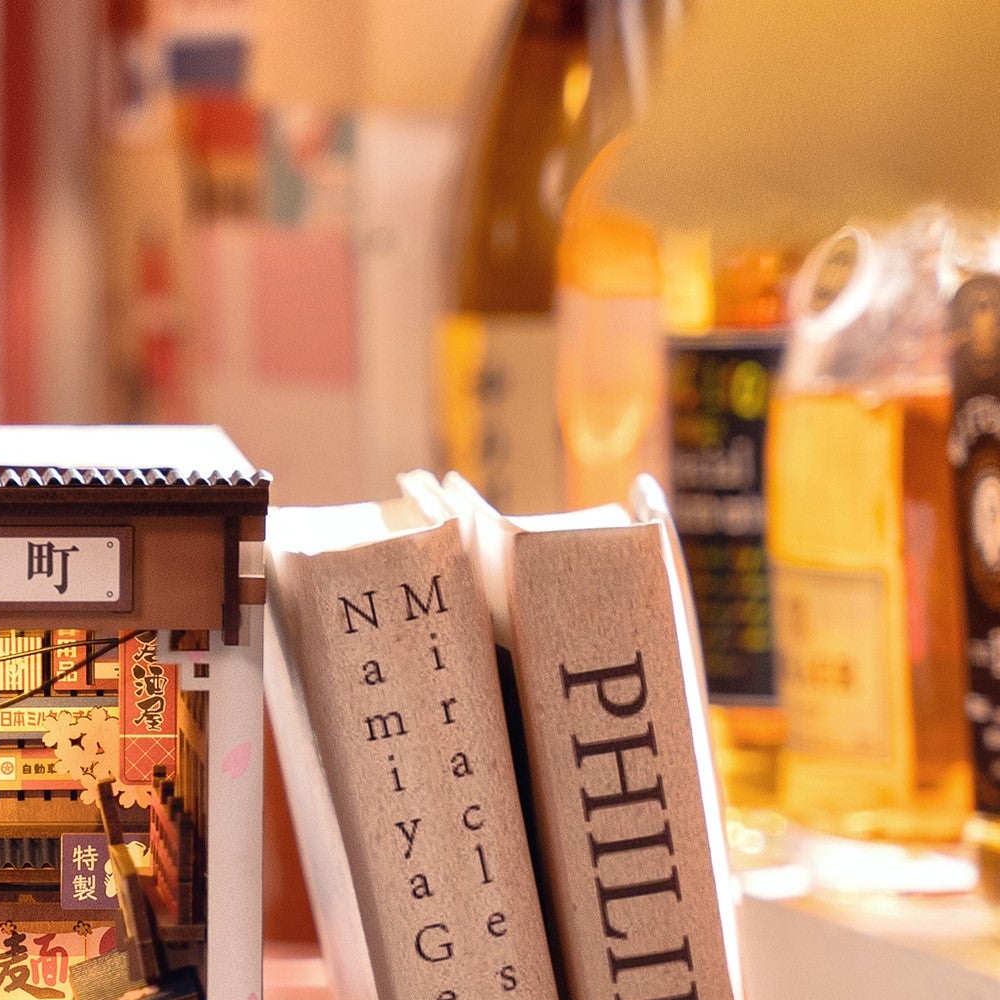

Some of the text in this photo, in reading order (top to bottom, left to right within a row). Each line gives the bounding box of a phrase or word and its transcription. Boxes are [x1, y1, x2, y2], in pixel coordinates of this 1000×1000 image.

[72, 844, 99, 901] 特製
[337, 590, 434, 900] Namiya
[400, 575, 519, 992] Miracles
